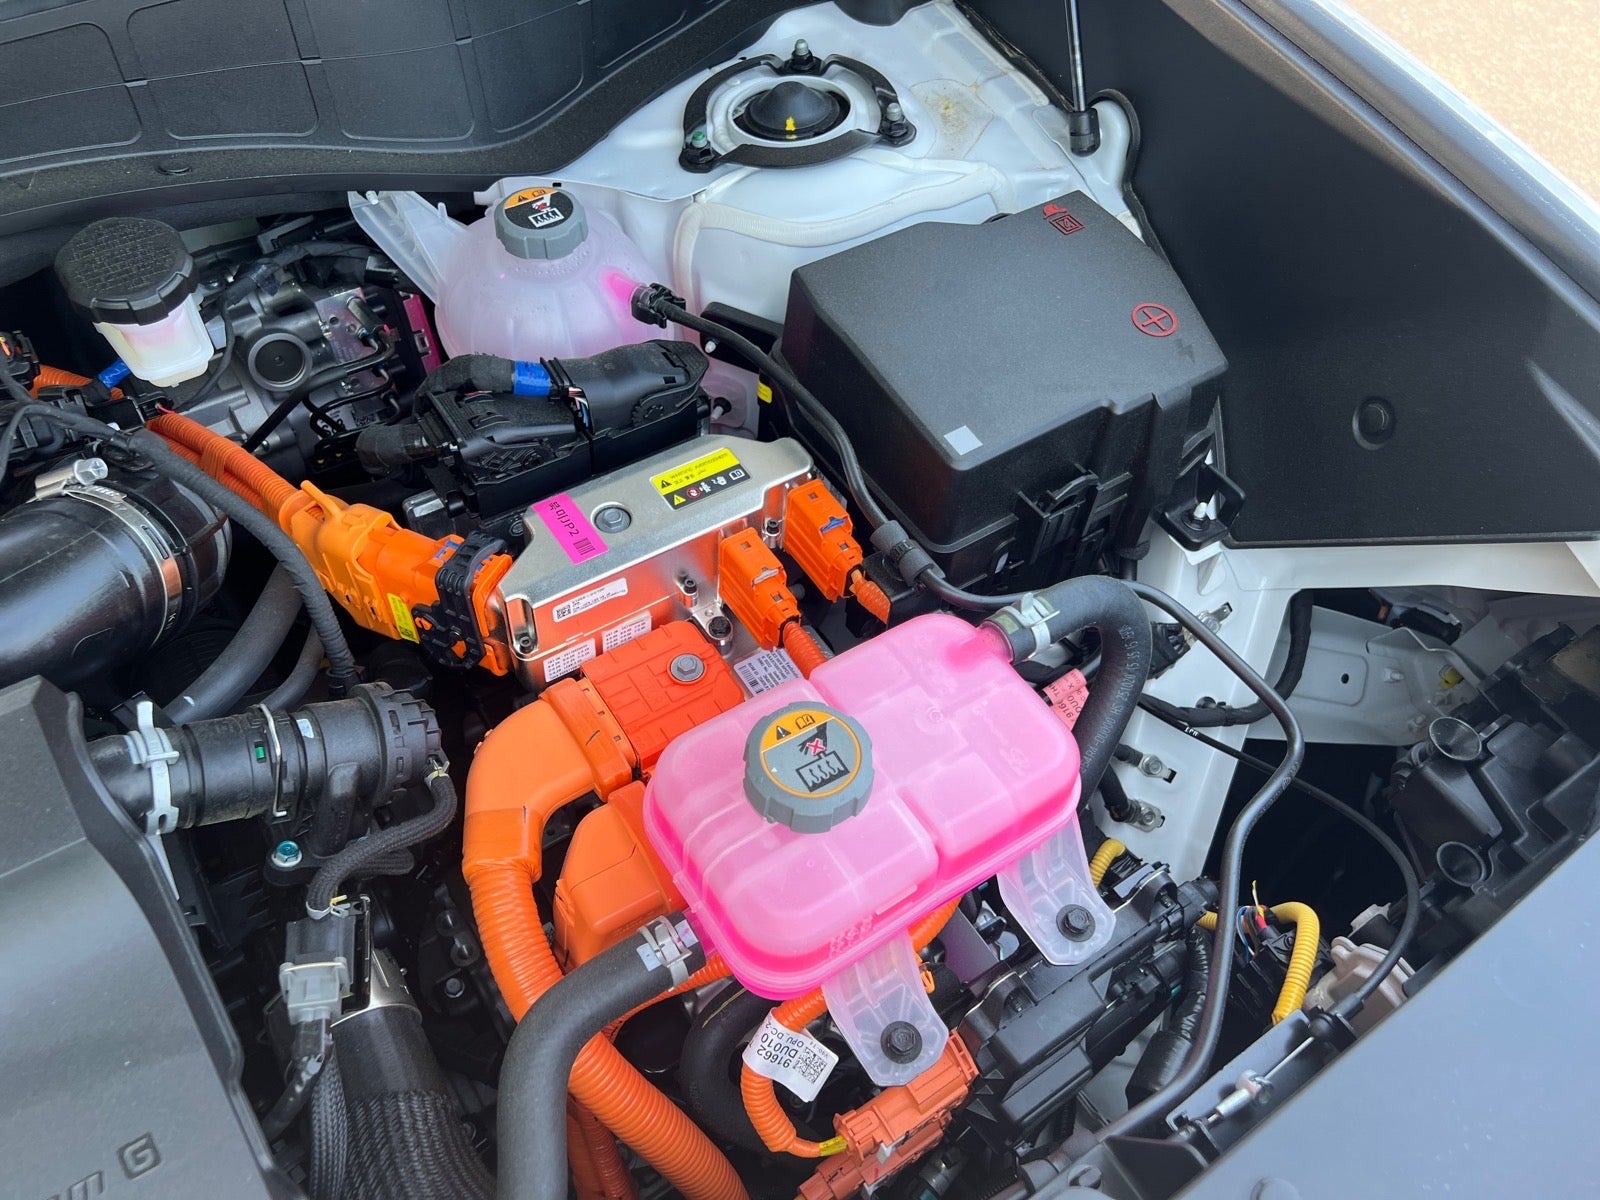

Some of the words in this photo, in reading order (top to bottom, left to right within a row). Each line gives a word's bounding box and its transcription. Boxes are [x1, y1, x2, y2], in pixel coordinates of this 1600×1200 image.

[756, 1044, 793, 1069] 91662
[760, 1033, 799, 1059] DU010
[120, 1134, 158, 1176] G
